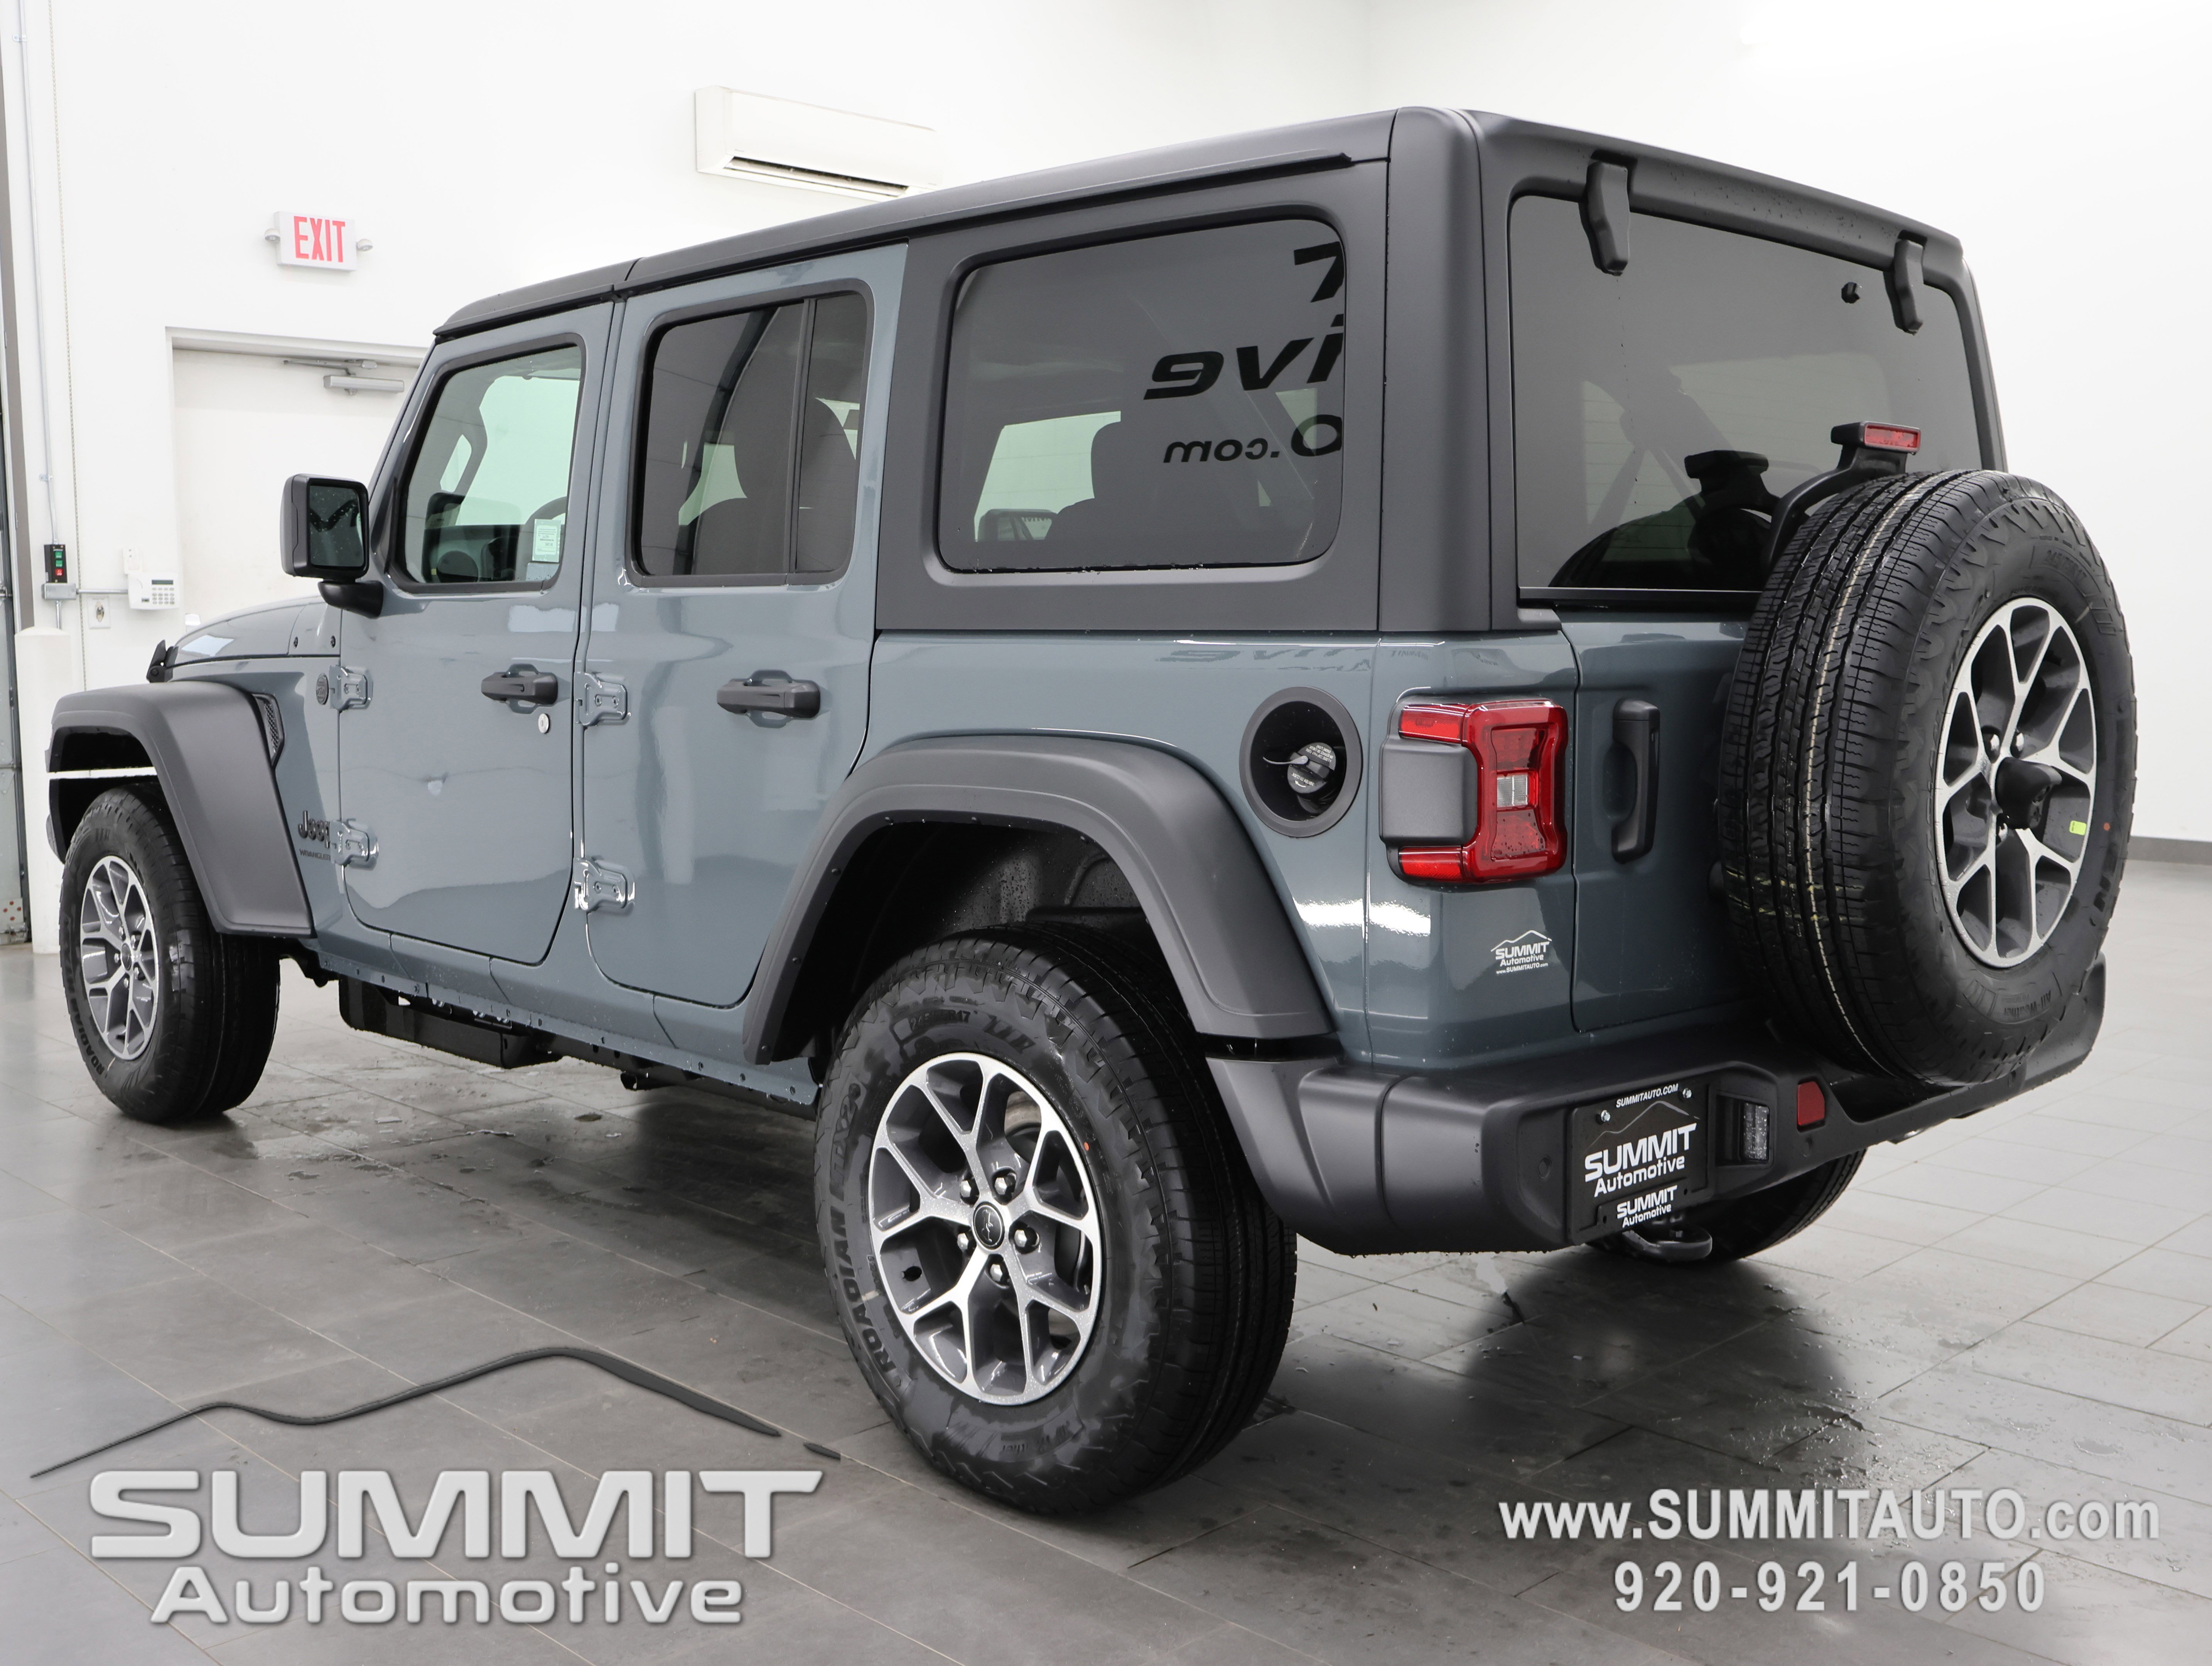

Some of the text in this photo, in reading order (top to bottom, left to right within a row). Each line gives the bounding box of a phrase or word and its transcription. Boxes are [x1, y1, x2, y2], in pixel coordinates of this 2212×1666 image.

[294, 216, 345, 263] EXIT
[298, 810, 331, 849] Jeep
[1495, 941, 1550, 960] SUMMIT
[1500, 954, 1544, 967] Automotive
[1496, 962, 1548, 974] www.SUMMITAUTO.com
[1616, 1084, 1679, 1108] SUMMITAUTO.COM
[1585, 1123, 1697, 1182] SUMMIT
[1594, 1156, 1685, 1197] Automotive
[1616, 1185, 1678, 1219] SUMMIT
[1622, 1202, 1672, 1228] Automotive
[830, 1206, 897, 1371] ROADIAN
